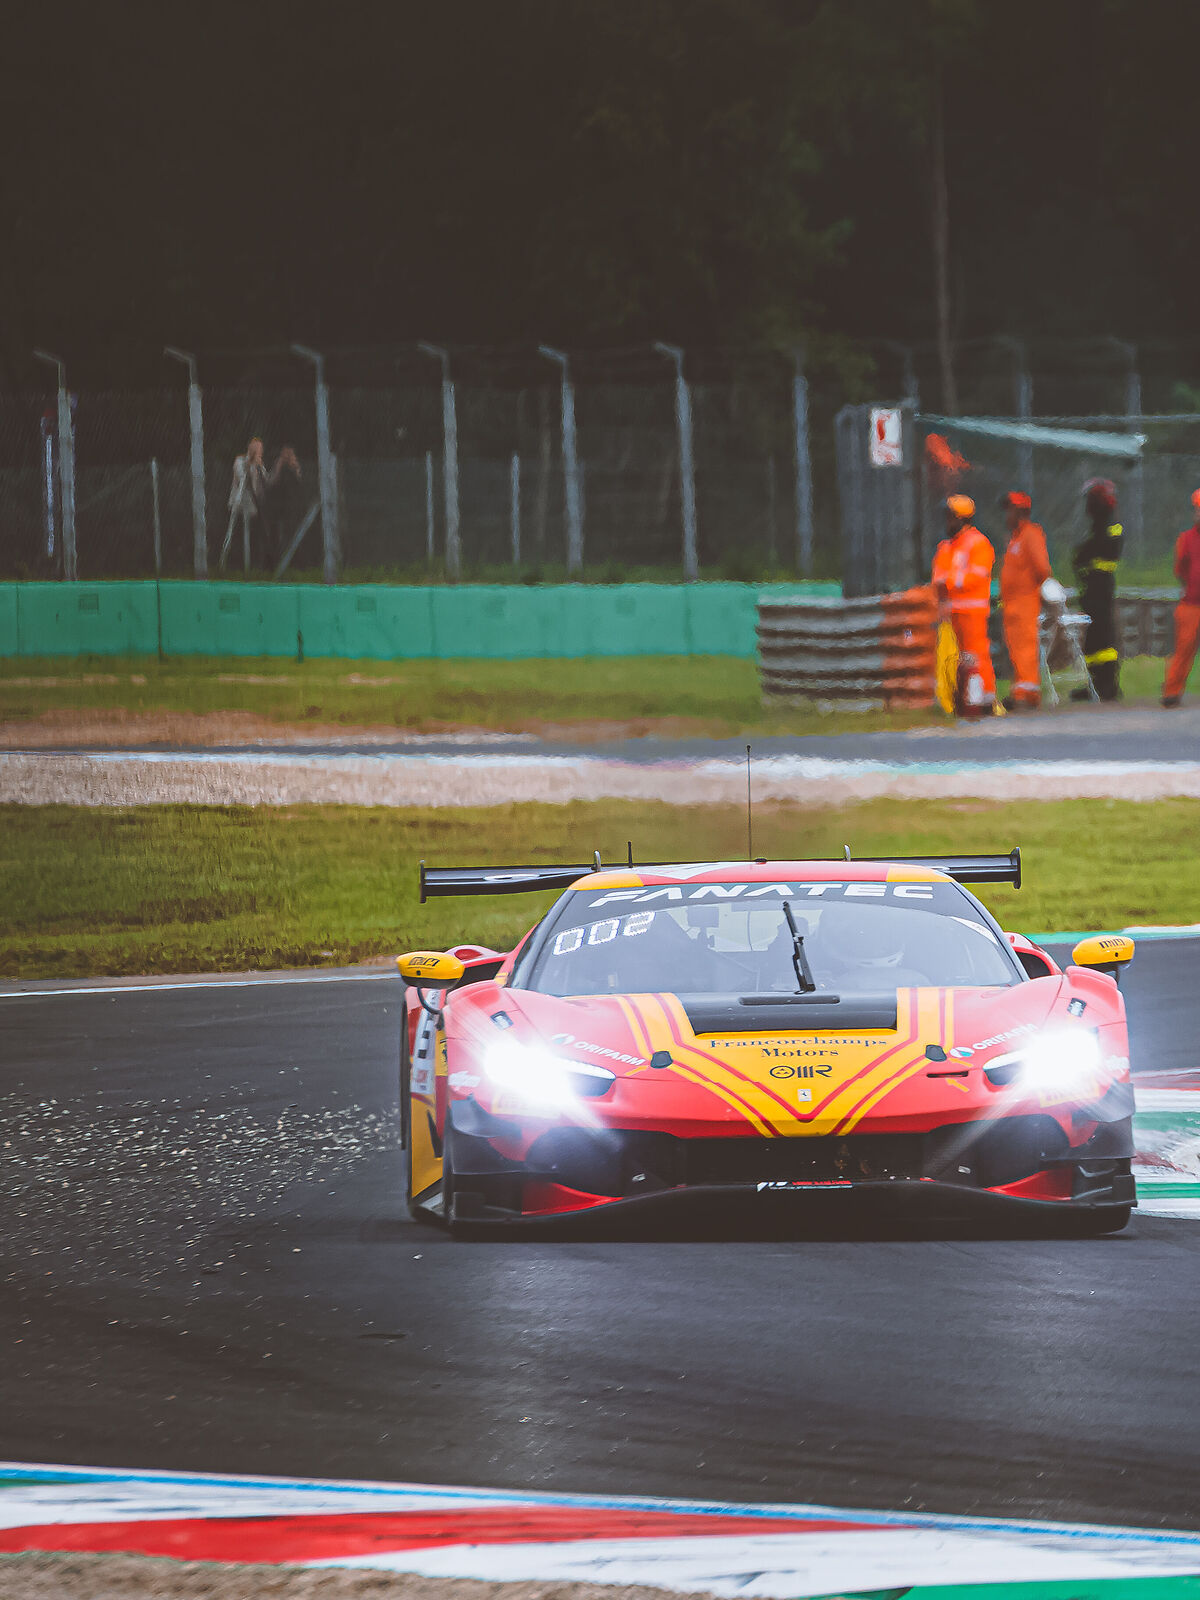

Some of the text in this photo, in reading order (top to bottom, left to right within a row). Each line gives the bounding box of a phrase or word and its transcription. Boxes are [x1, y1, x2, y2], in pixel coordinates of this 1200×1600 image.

[588, 882, 934, 908] FANATEC
[553, 910, 656, 956] 002
[573, 1041, 646, 1066] ORIFARM
[710, 1036, 887, 1048] Francorchamps
[760, 1048, 840, 1059] Motors
